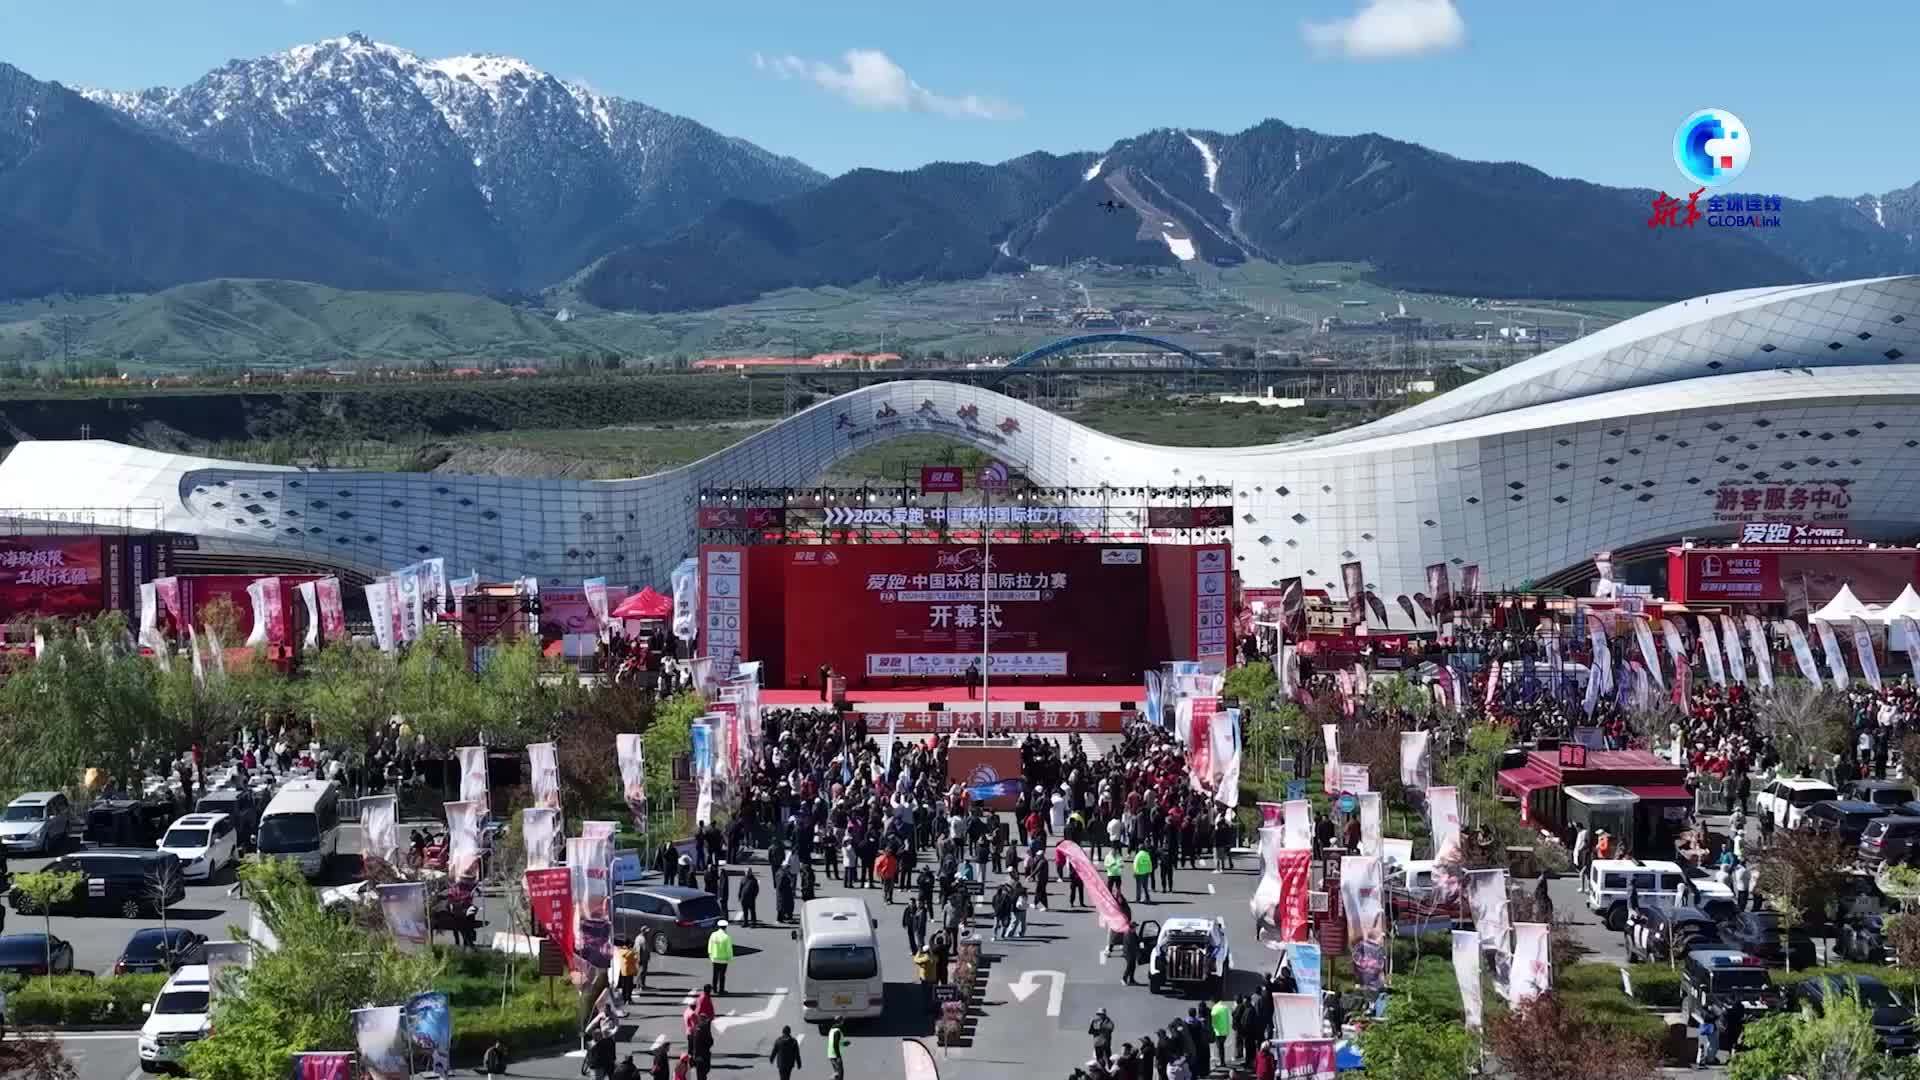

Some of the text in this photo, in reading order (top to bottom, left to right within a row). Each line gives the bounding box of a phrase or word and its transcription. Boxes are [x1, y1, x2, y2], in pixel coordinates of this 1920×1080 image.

[1714, 487, 1852, 511] 游客服务中心
[1713, 511, 1849, 521] Tourist Service Center
[1741, 523, 1792, 543] 爱跑
[0, 550, 65, 568] 海驭极限
[866, 572, 1067, 590] 爱跑·中国环塔国际拉力赛
[930, 604, 1003, 628] 开幕式
